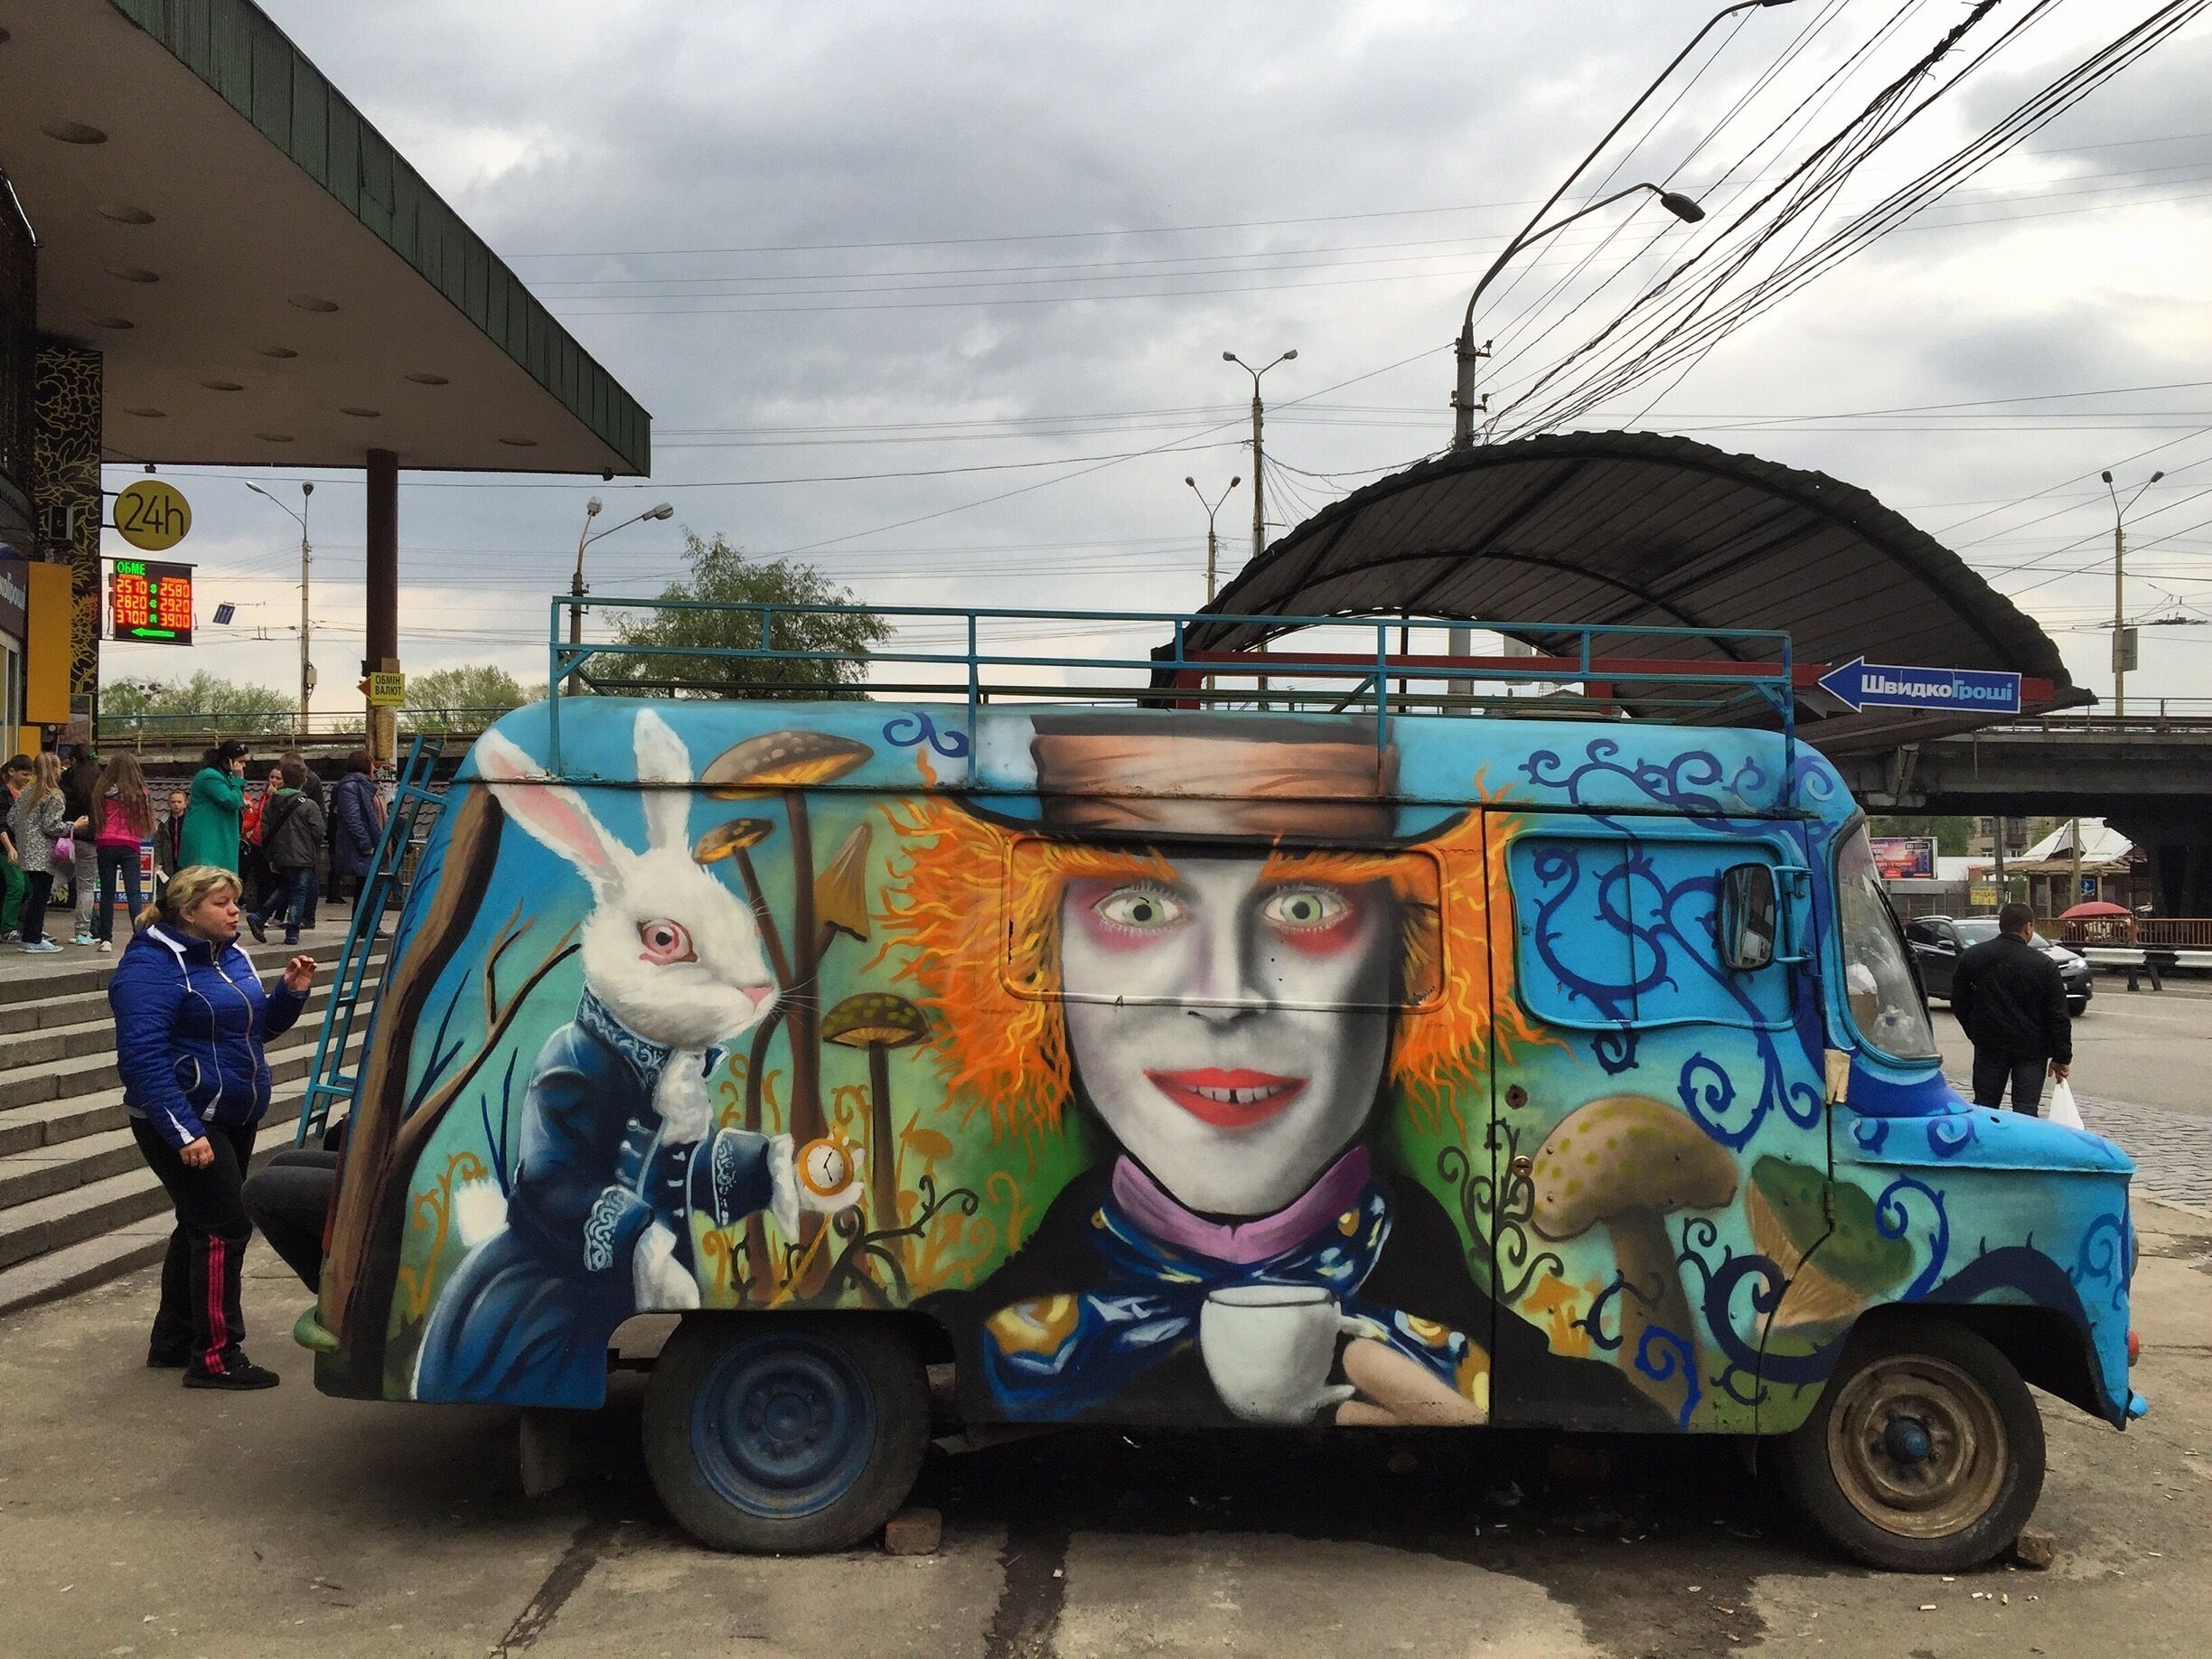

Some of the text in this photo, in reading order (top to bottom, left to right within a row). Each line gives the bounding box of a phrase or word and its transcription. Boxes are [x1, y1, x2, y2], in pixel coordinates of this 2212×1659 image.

[125, 492, 184, 537] 24h
[117, 578, 147, 595] 2510
[160, 583, 190, 598] 2580
[117, 594, 147, 610] 2820
[160, 597, 190, 614] 2920
[117, 609, 147, 625] 3700
[160, 613, 190, 628] 3900
[375, 675, 400, 685] ОБМІН
[1861, 674, 2012, 701] ШвидкоГроші
[375, 686, 402, 696] ВАЛЮТ
